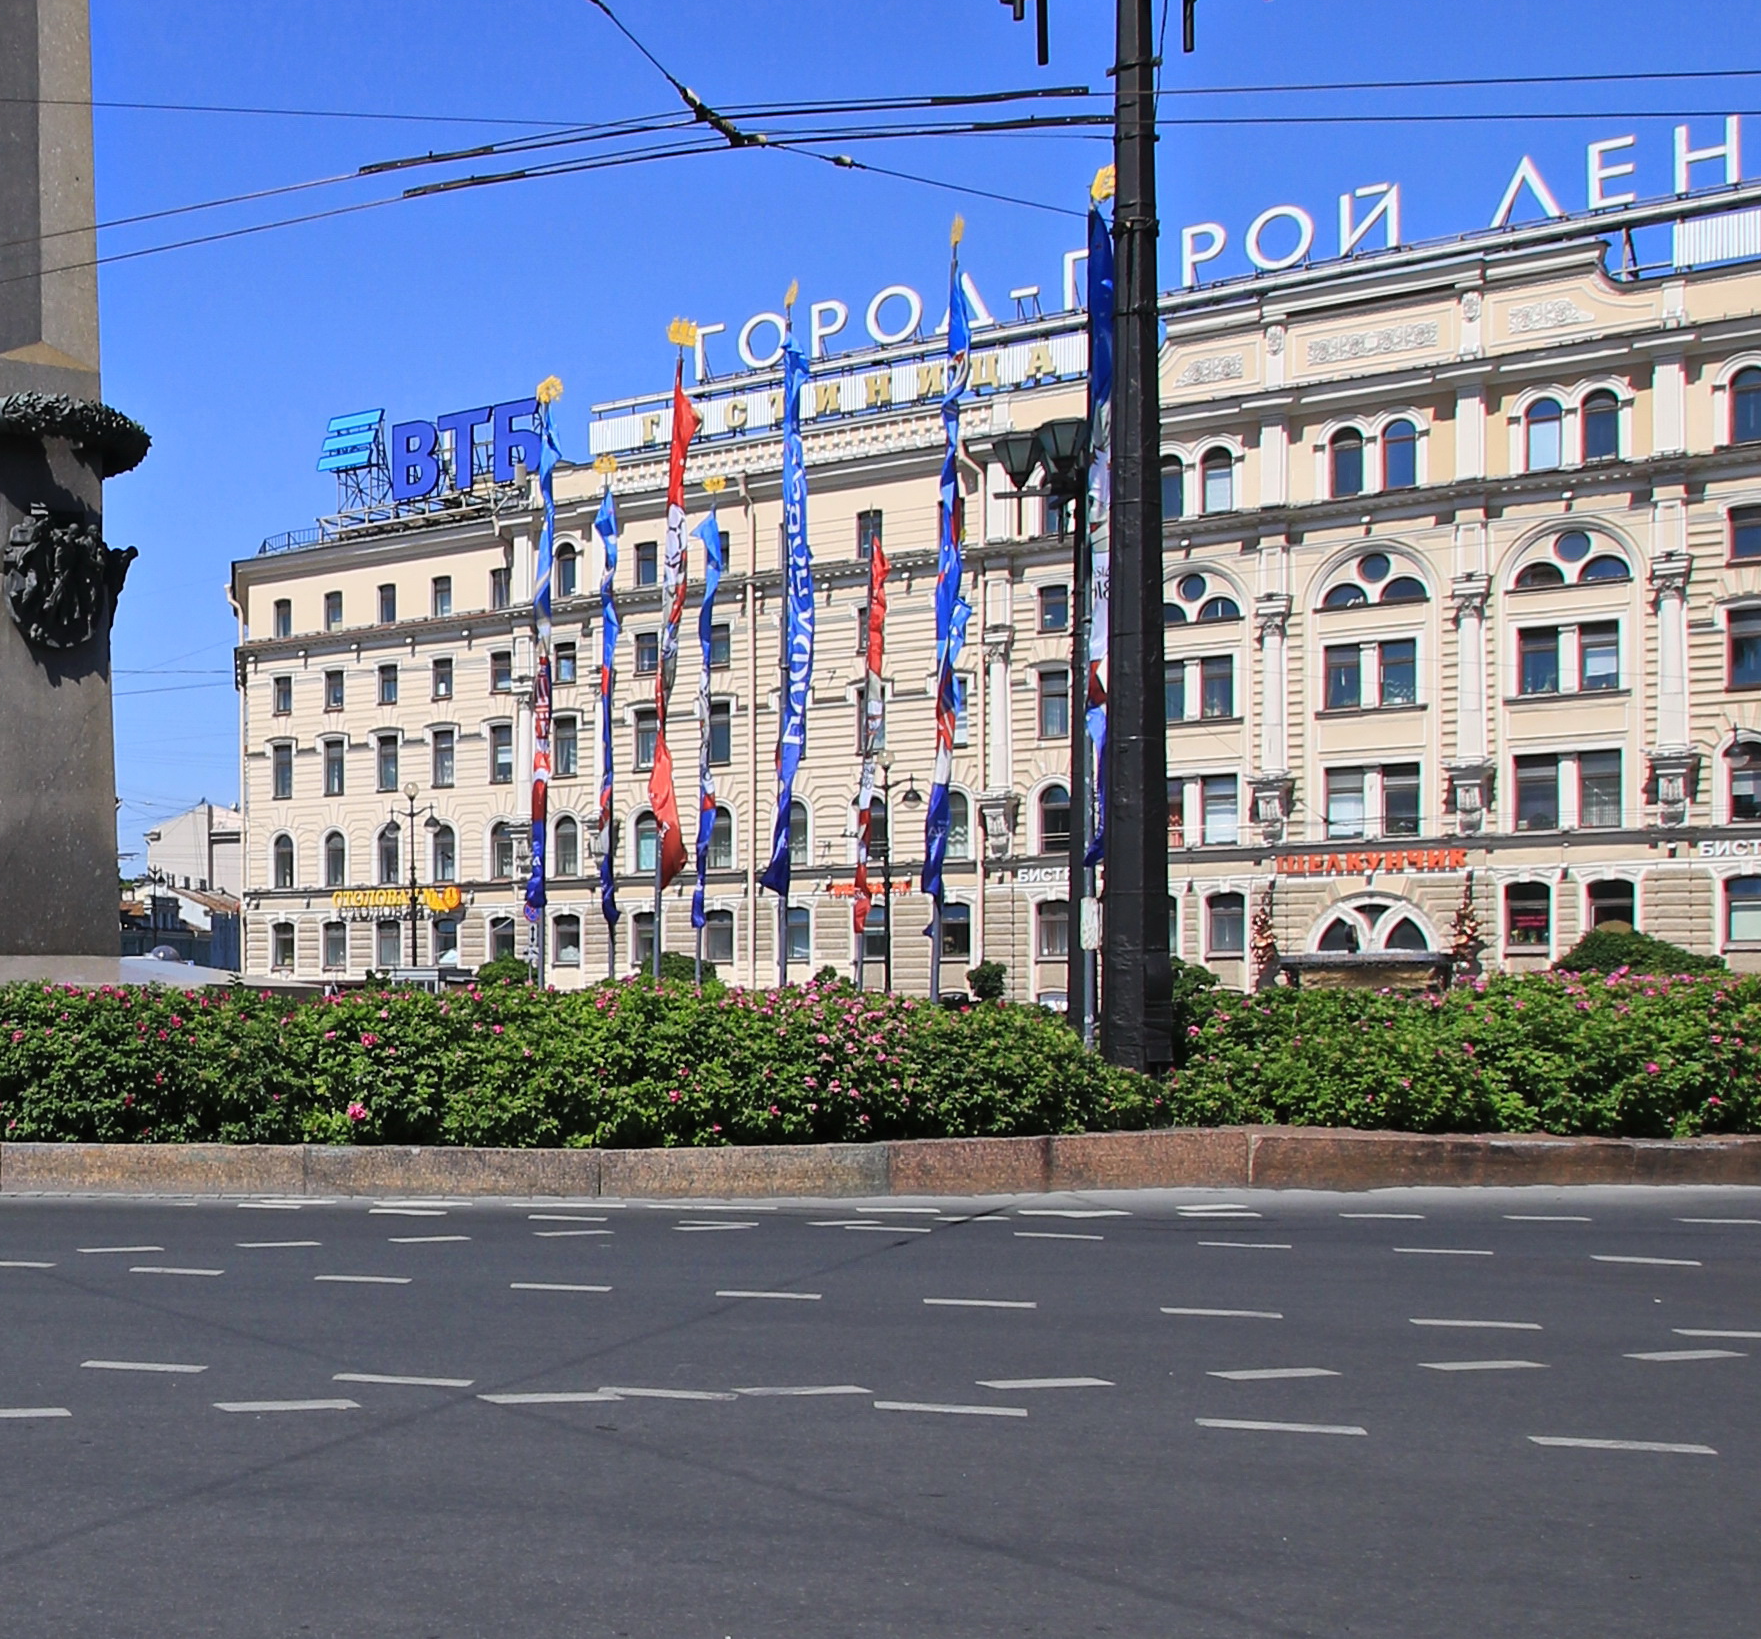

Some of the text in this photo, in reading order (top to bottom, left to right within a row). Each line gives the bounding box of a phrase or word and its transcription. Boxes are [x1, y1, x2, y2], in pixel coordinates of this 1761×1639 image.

[695, 114, 1742, 382] ГОРОД-ГРОЙ ЛЕН
[642, 344, 1057, 443] ГСТИНИЦА
[391, 396, 542, 501] ВТБ
[1276, 848, 1468, 874] ЩЕЛКУНЧИК
